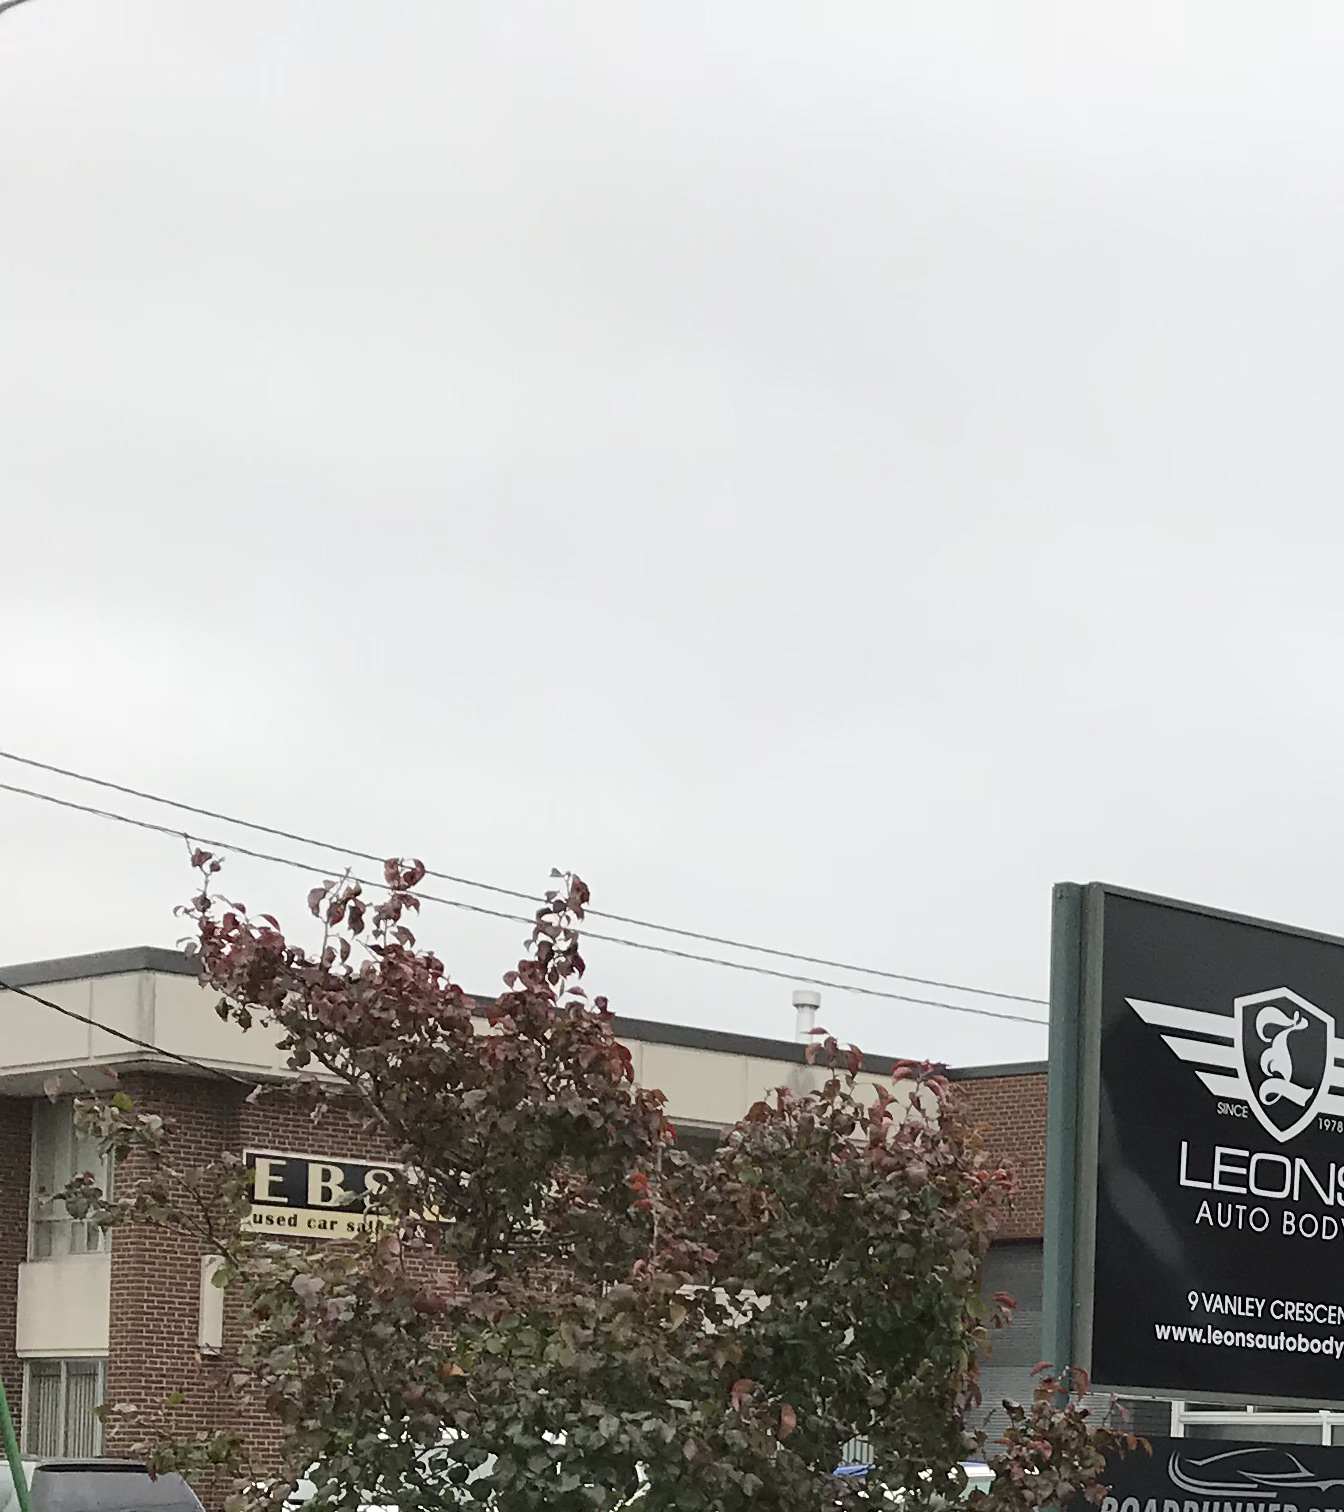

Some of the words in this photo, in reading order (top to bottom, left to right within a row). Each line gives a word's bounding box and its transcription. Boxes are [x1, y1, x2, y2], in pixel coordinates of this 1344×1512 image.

[1216, 1101, 1249, 1119] SINCE
[1318, 1117, 1344, 1134] 1978
[253, 1212, 297, 1227] used
[307, 1217, 338, 1230] car
[1195, 1200, 1270, 1232] AUTO
[1187, 1290, 1199, 1311] 9
[1201, 1293, 1266, 1319] VANLEY
